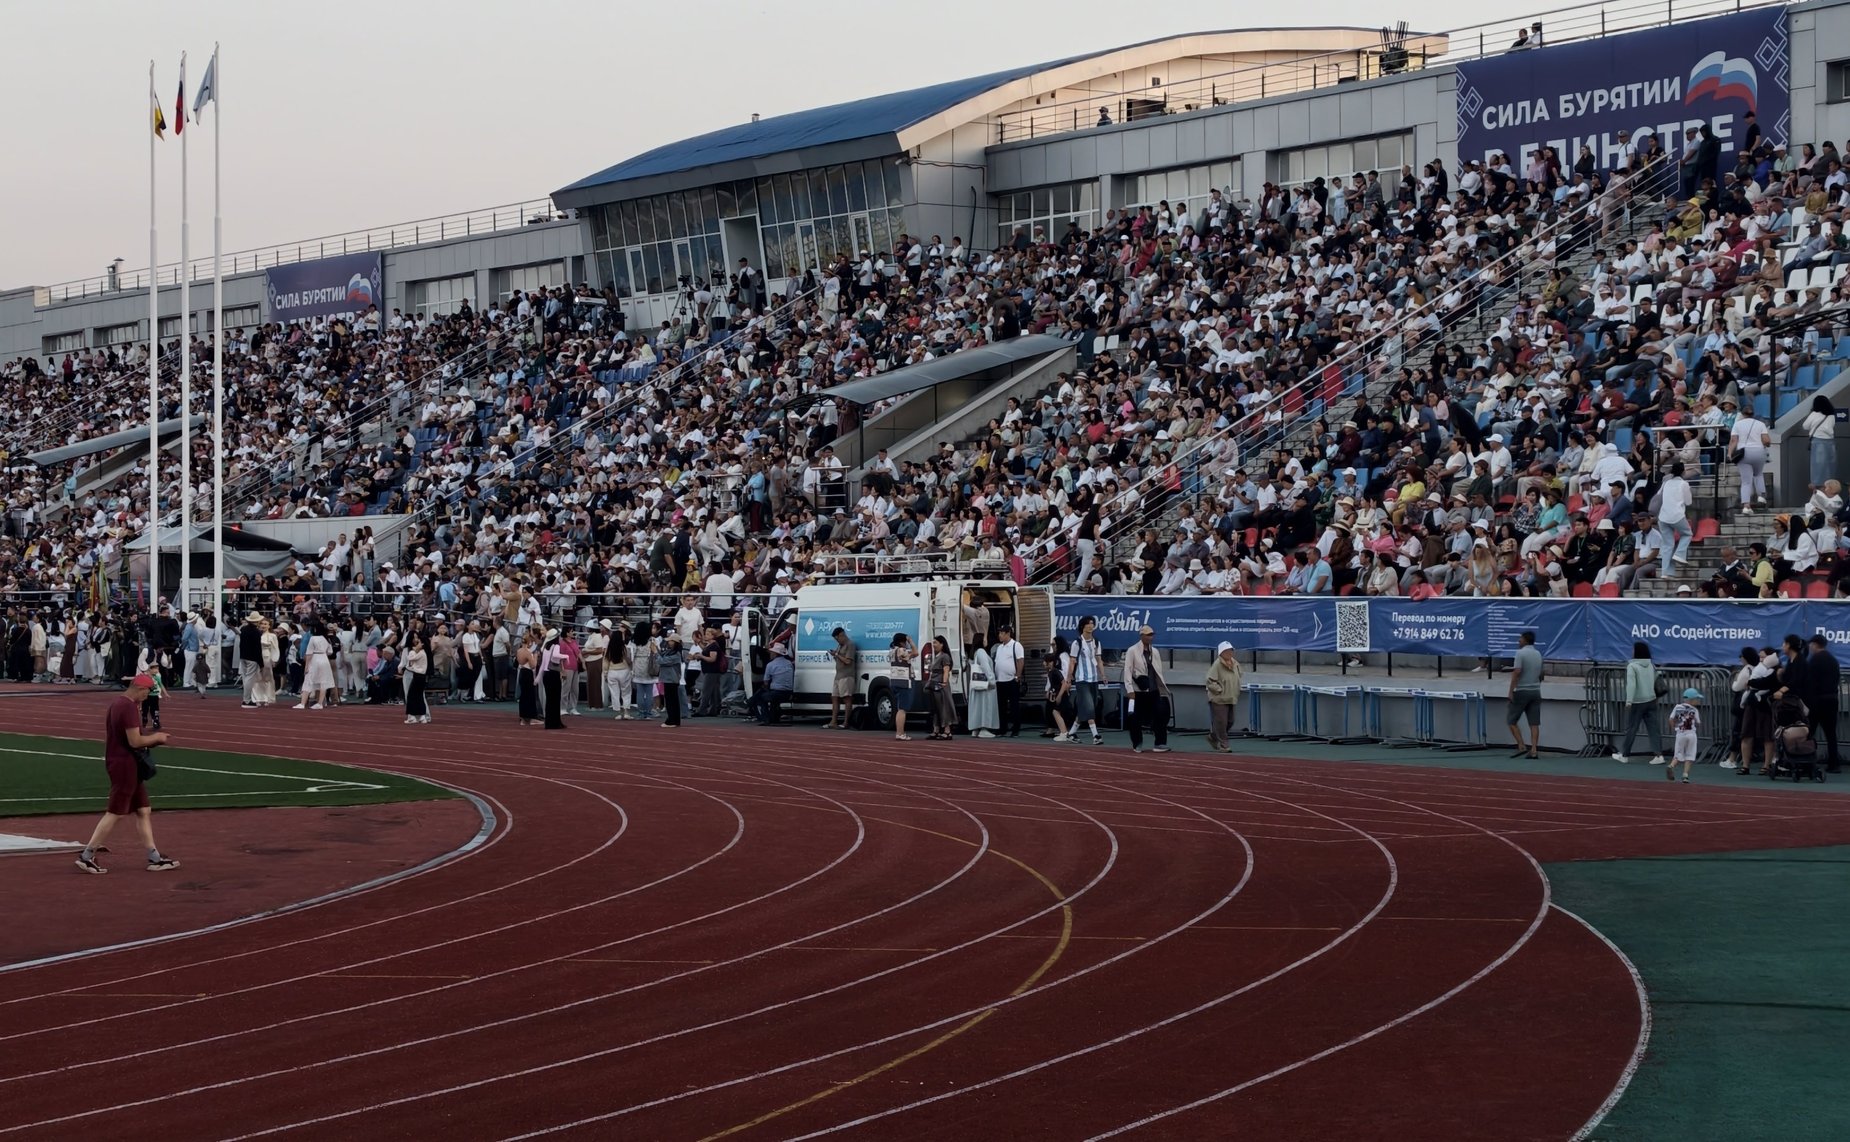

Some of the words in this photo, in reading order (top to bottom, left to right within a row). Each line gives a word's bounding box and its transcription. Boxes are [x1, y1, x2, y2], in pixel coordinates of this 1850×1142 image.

[1482, 97, 1550, 130] СИЛА
[1559, 76, 1681, 119] БУРЯТИИ
[275, 292, 300, 310] СИЛА
[302, 286, 346, 306] БУРЯТИИ
[1391, 612, 1425, 624] Перевод
[1425, 615, 1436, 624] по
[1436, 615, 1466, 626] номеру
[1404, 628, 1419, 639] 914
[1420, 628, 1438, 639] 849
[1439, 628, 1452, 640] 62
[1453, 628, 1465, 640] 76
[1631, 623, 1660, 638] АНО
[1664, 623, 1762, 641] «Содействие»
[798, 654, 822, 663] ПРЯМОЕ
